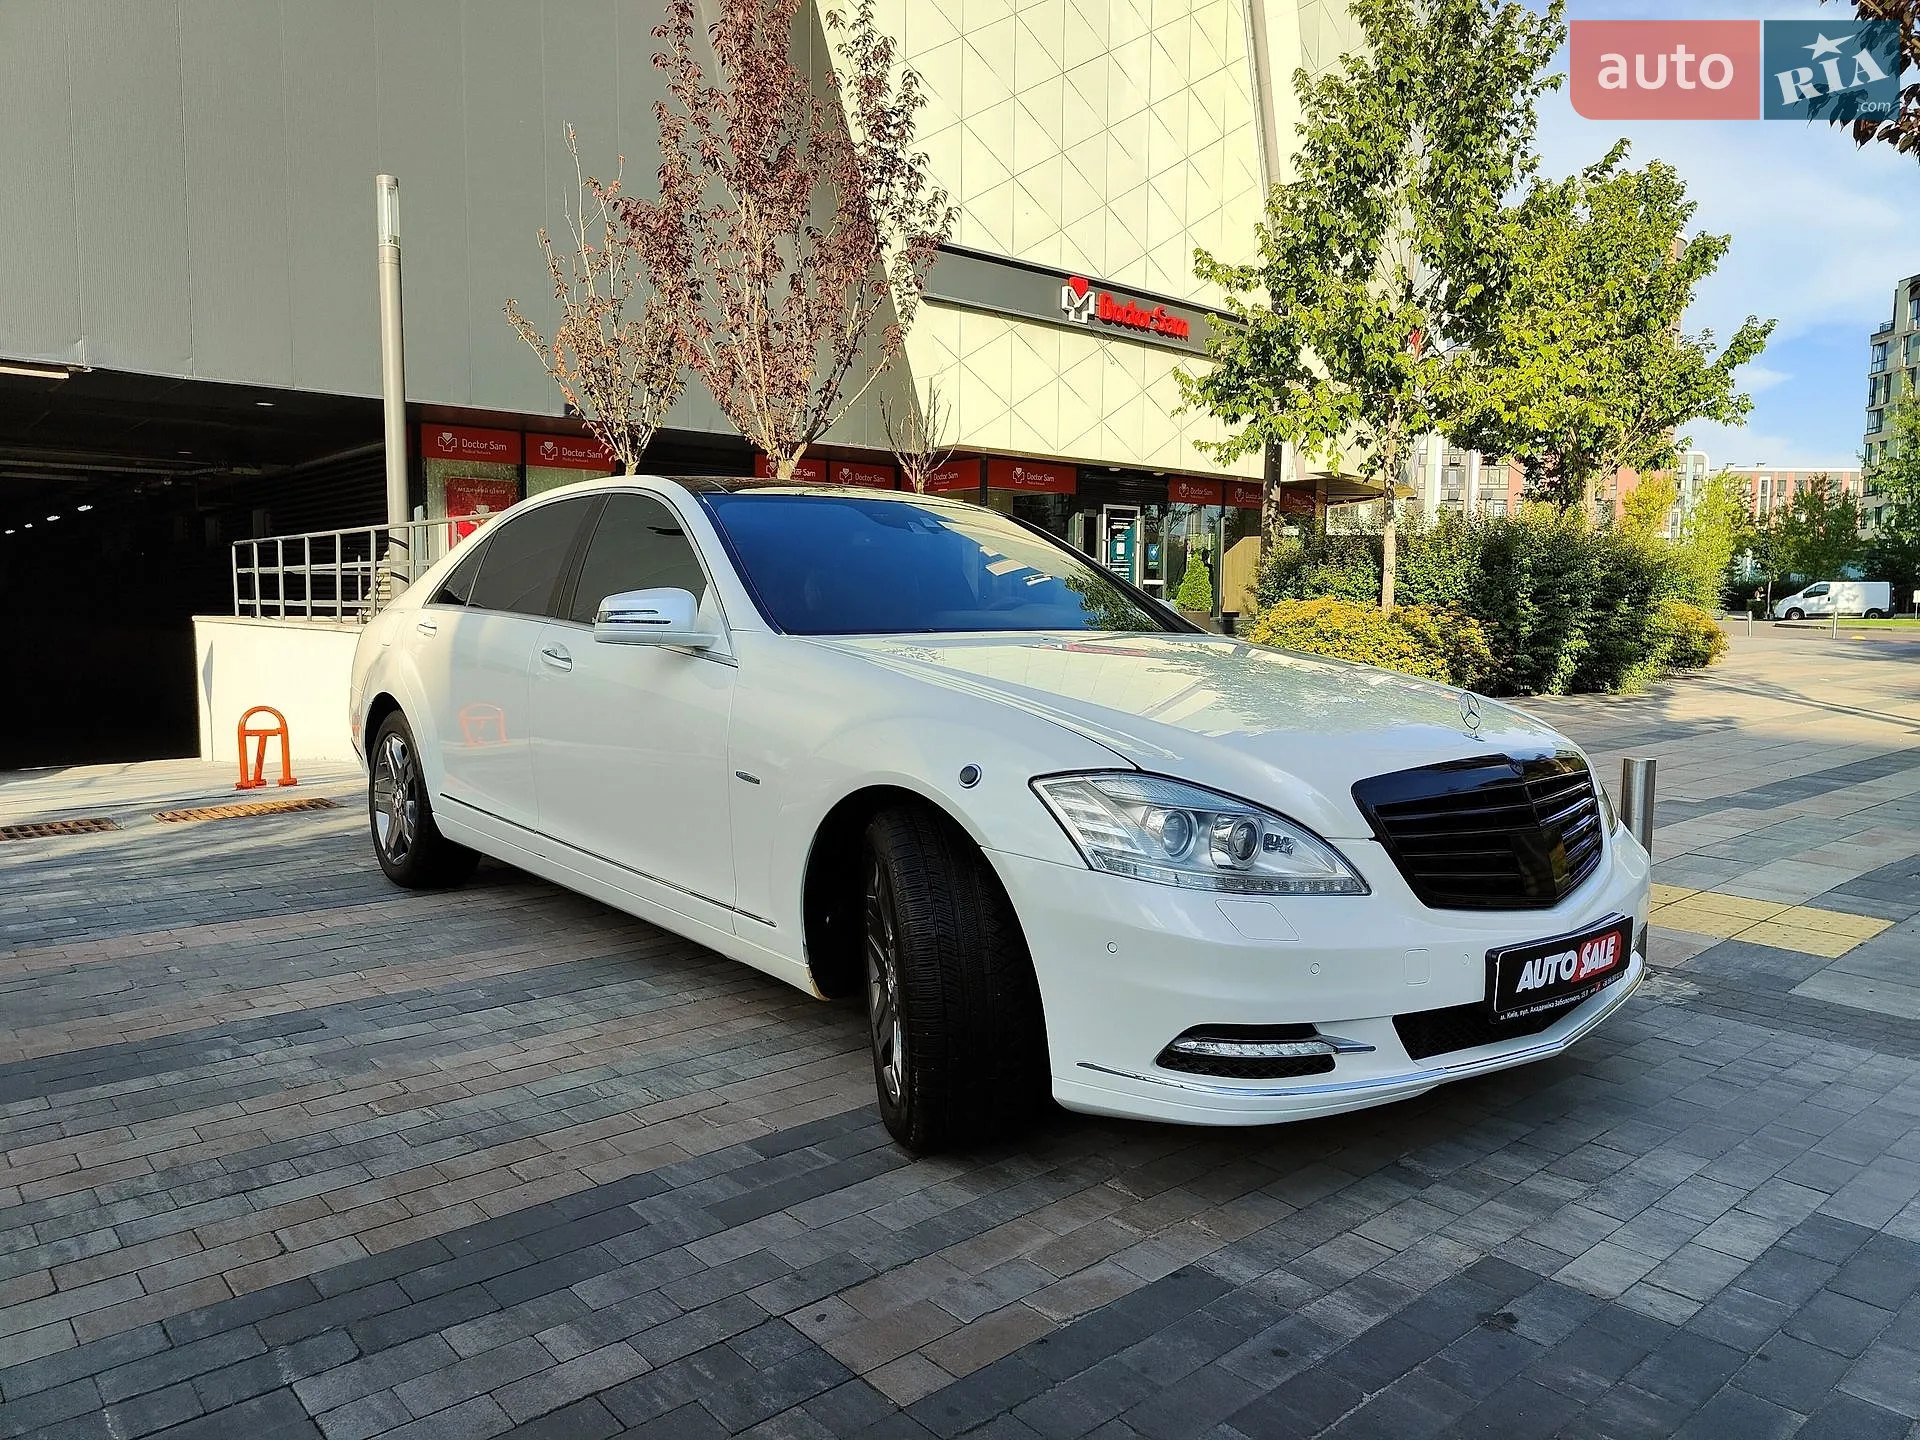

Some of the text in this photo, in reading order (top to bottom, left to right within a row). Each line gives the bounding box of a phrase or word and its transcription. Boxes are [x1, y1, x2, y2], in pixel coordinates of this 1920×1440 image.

[1099, 292, 1189, 338] Doctor Sam
[461, 438, 507, 451] Doctor Sam
[561, 447, 603, 459] Doctor Sam
[803, 469, 816, 477] Sam
[855, 472, 885, 482] Doctor Sam
[933, 471, 959, 481] Doctor Sam
[1026, 472, 1055, 482] Doctor Sam
[1516, 936, 1616, 993] AUTO SALE
